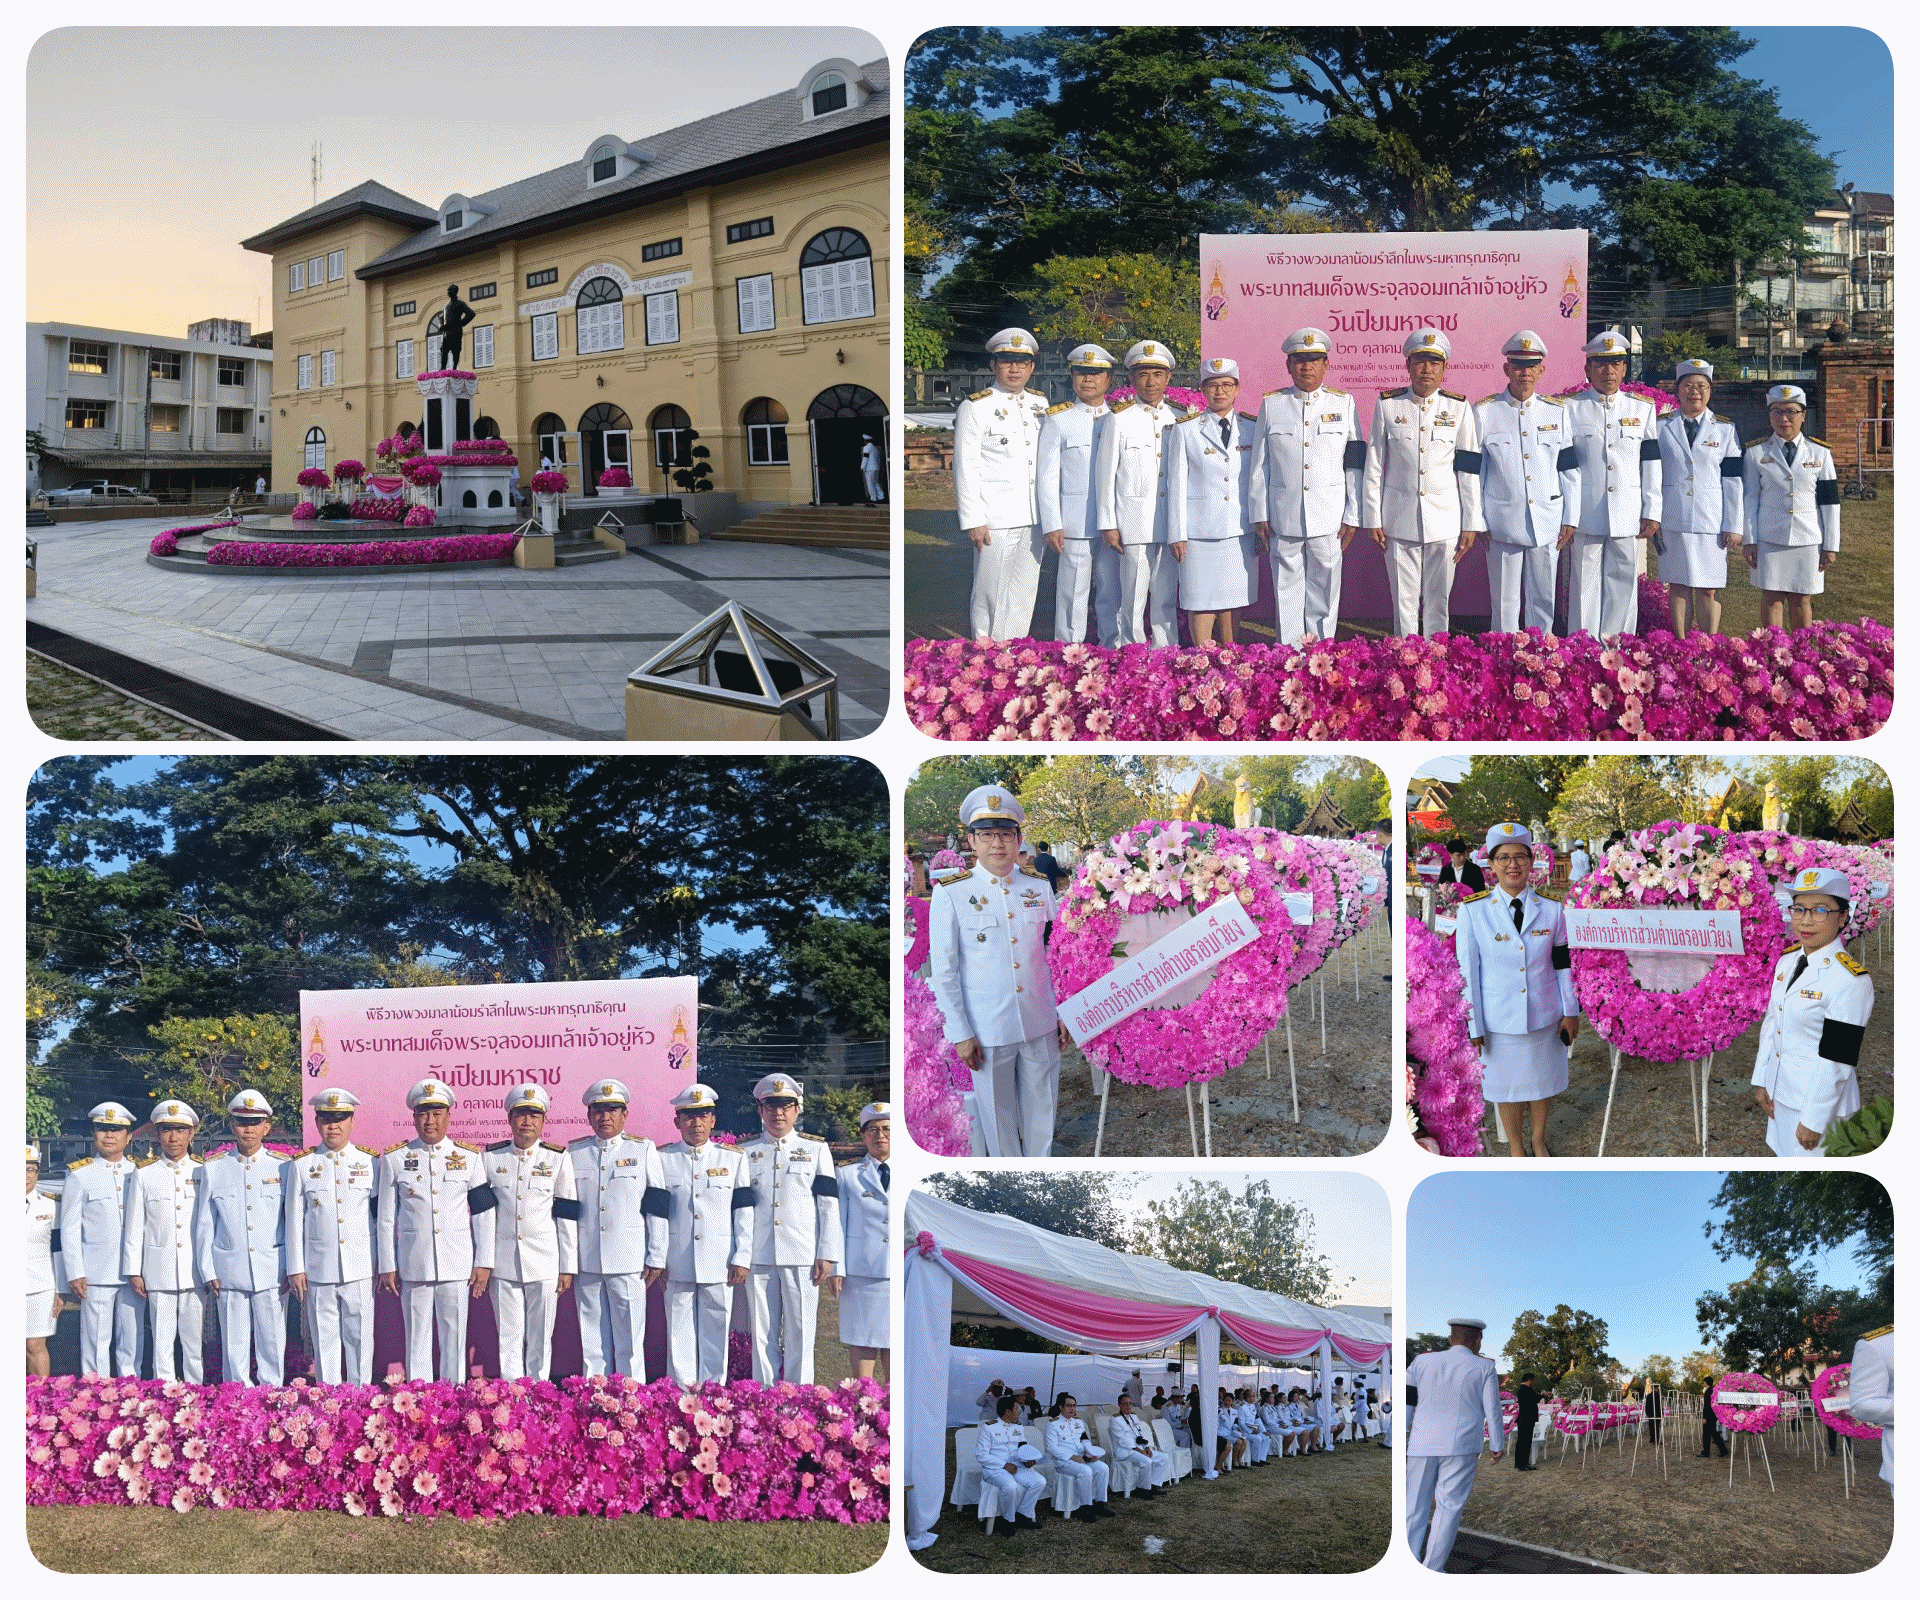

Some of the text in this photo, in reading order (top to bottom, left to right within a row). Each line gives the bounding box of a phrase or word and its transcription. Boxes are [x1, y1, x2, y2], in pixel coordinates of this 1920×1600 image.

[1266, 248, 1521, 268] พิธีวางพวงมาลาน้อมรำลึกในพระมหากรุณาธิคุณ
[1240, 275, 1548, 300] พระบาทสมเด็จพระจุลจอมเกล้าเจ้าอยู่หัว
[1328, 308, 1458, 332] วันปิยมหาราช
[1362, 343, 1402, 358] ตุลาคม
[1575, 913, 1733, 948] องค์การบริหารส่วนตำบลรอบเวียง
[1075, 915, 1246, 1034] องค์การบริหารส่วนตำบลรอบเวียง
[366, 1000, 627, 1022] พิธีวางพวงมาลาน้อมรำลึกในพระมหากรุณาธิคุณ
[340, 1025, 656, 1055] พระบาทสมเด็จพระจุลจอมเกล้าเจ้าอยู่หัว
[463, 1098, 503, 1112] ตุลาคม
